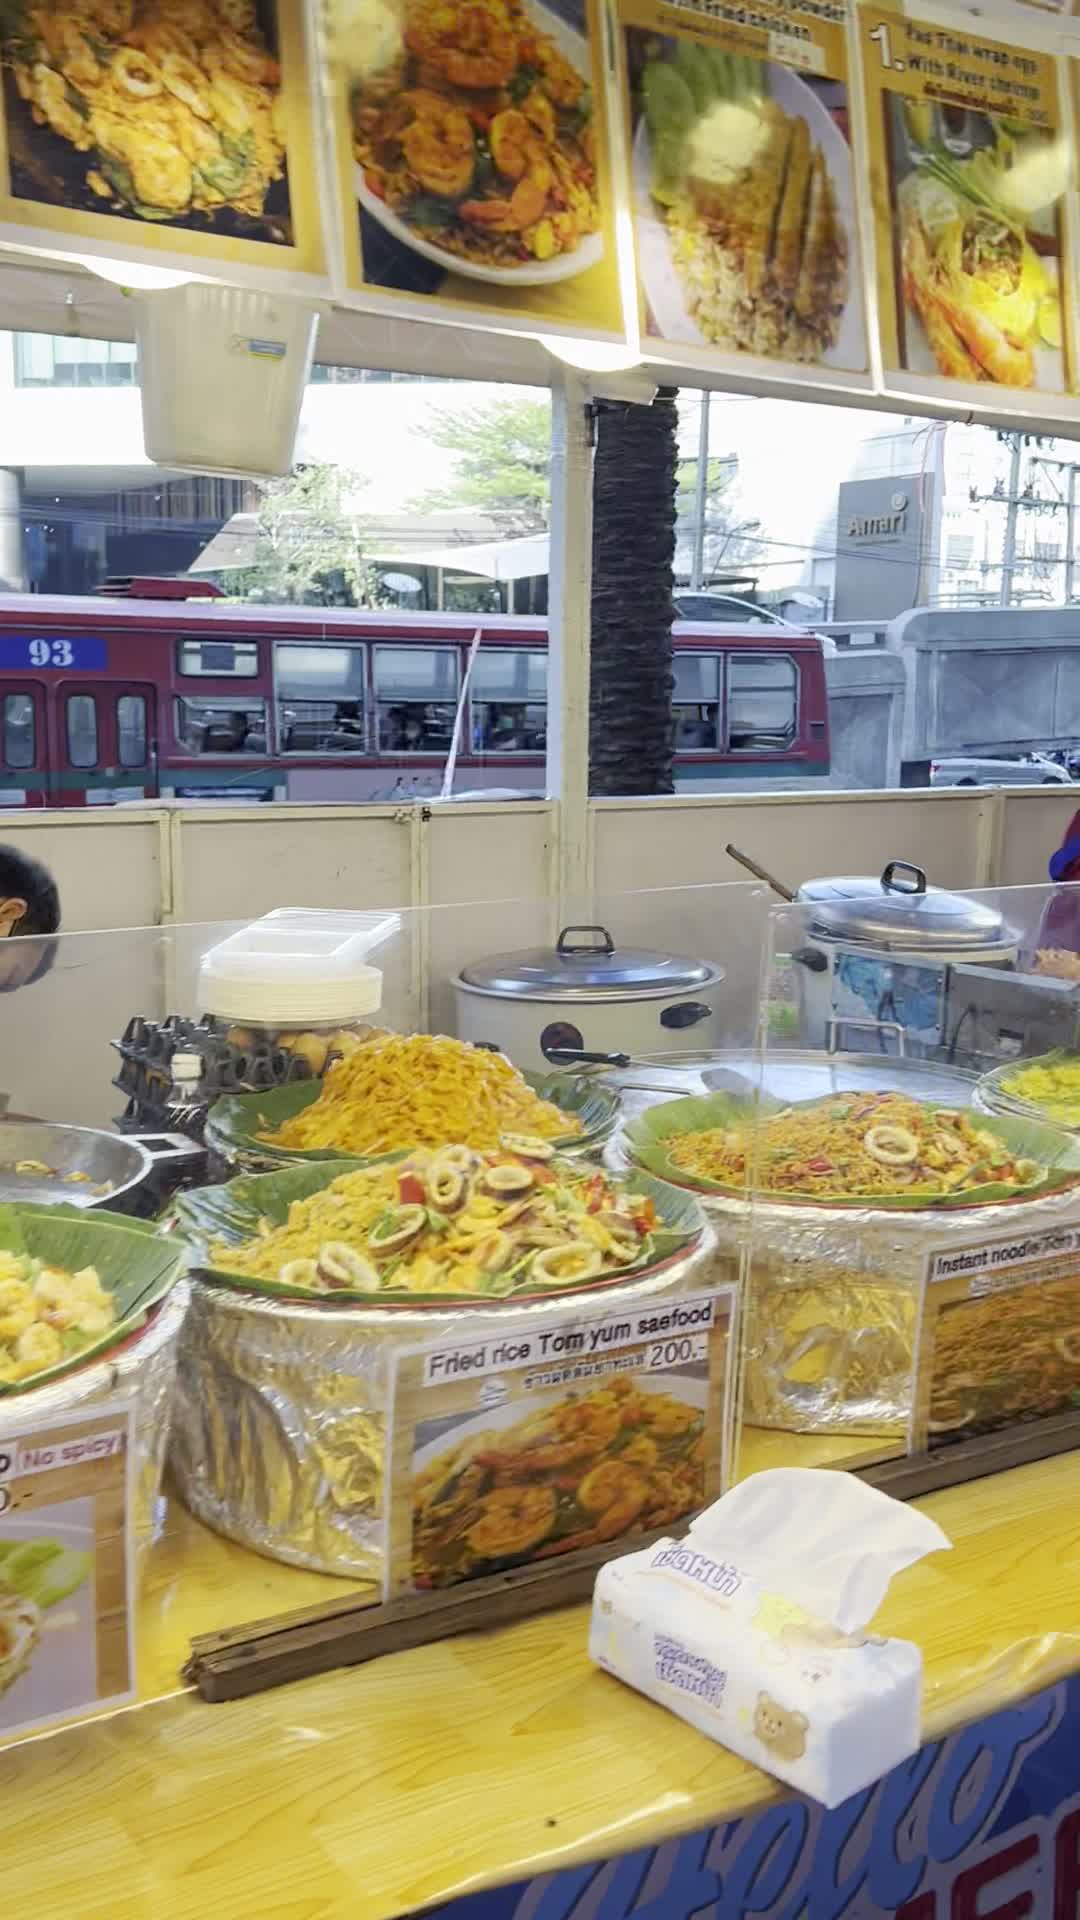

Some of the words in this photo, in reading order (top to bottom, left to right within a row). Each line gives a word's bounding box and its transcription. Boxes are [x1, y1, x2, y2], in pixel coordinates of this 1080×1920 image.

[869, 22, 906, 72] 1.
[847, 504, 907, 537] Amari
[28, 639, 74, 667] 93
[936, 1250, 988, 1275] Instant
[429, 1346, 486, 1378] Fried
[492, 1342, 531, 1364] rice
[538, 1328, 584, 1355] Tom
[589, 1322, 631, 1350] yum
[650, 1339, 705, 1367] 200.-
[23, 1451, 55, 1468] No
